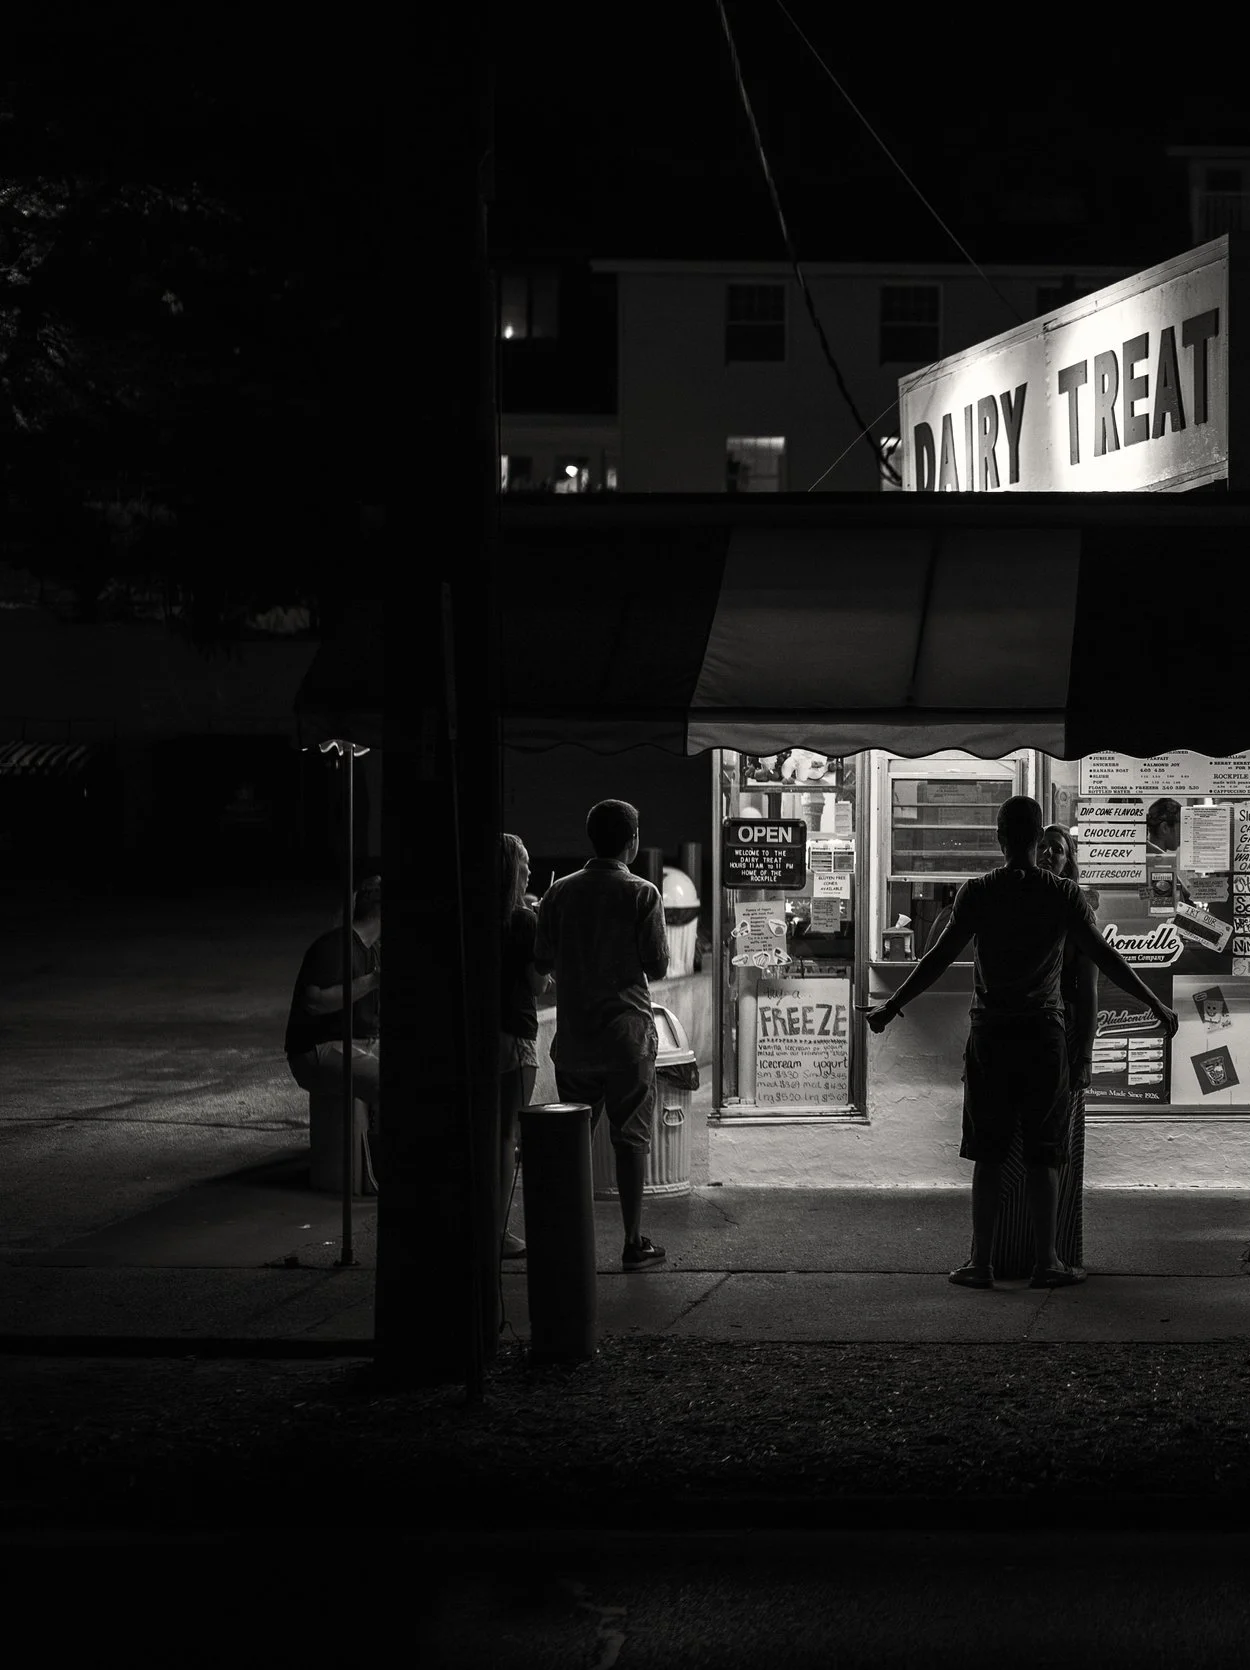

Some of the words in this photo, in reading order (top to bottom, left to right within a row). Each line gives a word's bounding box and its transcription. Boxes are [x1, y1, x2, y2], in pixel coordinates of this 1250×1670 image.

[913, 382, 1029, 492] DAIRY
[1058, 307, 1221, 466] TREAT
[1080, 808, 1094, 817] DIP
[1095, 807, 1113, 817] CONE
[1114, 807, 1144, 817] FLAVORS
[737, 826, 792, 843] OPEN
[1084, 829, 1137, 838] CHOCOLATE
[734, 849, 759, 857] WELCOME
[1089, 849, 1133, 858] CHERRY
[1080, 869, 1142, 879] BUTTERSCOTCH
[1137, 954, 1165, 962] Company
[759, 1003, 847, 1037] FREEZE
[813, 1057, 848, 1076] yogurt
[1109, 1089, 1126, 1097] Made
